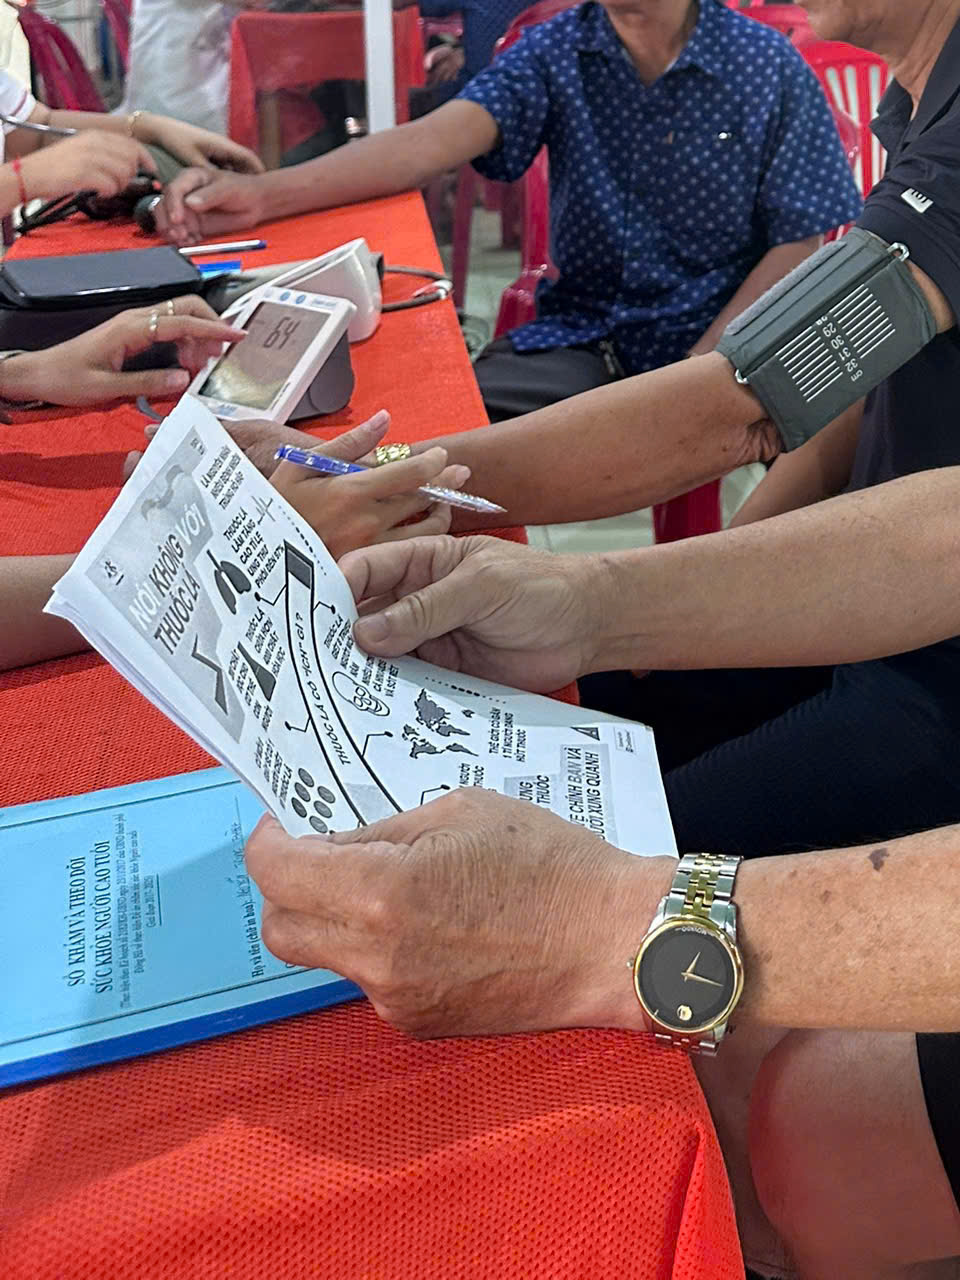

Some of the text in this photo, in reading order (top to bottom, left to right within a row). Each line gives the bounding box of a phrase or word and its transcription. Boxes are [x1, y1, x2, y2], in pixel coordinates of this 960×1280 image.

[822, 322, 837, 337] 29
[831, 335, 845, 350] 30
[839, 347, 852, 362] 31
[846, 358, 859, 373] 32
[850, 369, 864, 382] cm
[239, 545, 253, 565] CAO
[126, 503, 207, 631] NÓI KHÔNG VỚI
[153, 565, 202, 654] THUỐC LÁ
[308, 681, 321, 700] CÓ
[253, 699, 262, 719] CON
[489, 720, 500, 728] CÓ
[322, 723, 351, 765] THUỐC
[502, 728, 513, 747] NGƯỜI
[515, 728, 526, 748] THUỐC
[487, 742, 499, 754] THẾ
[564, 748, 581, 760] VÀ
[533, 774, 550, 804] THUỐC
[585, 752, 603, 814] XUNG QUANH
[564, 784, 584, 812] CHÍNH
[94, 868, 111, 891] CAO
[69, 878, 86, 909] THEO
[64, 909, 86, 927] VÀ
[90, 893, 112, 930] NGƯỜI
[245, 918, 256, 926] in
[248, 943, 260, 955] tên
[249, 955, 262, 964] và
[91, 966, 113, 993] SỨC
[252, 965, 266, 978] Họ
